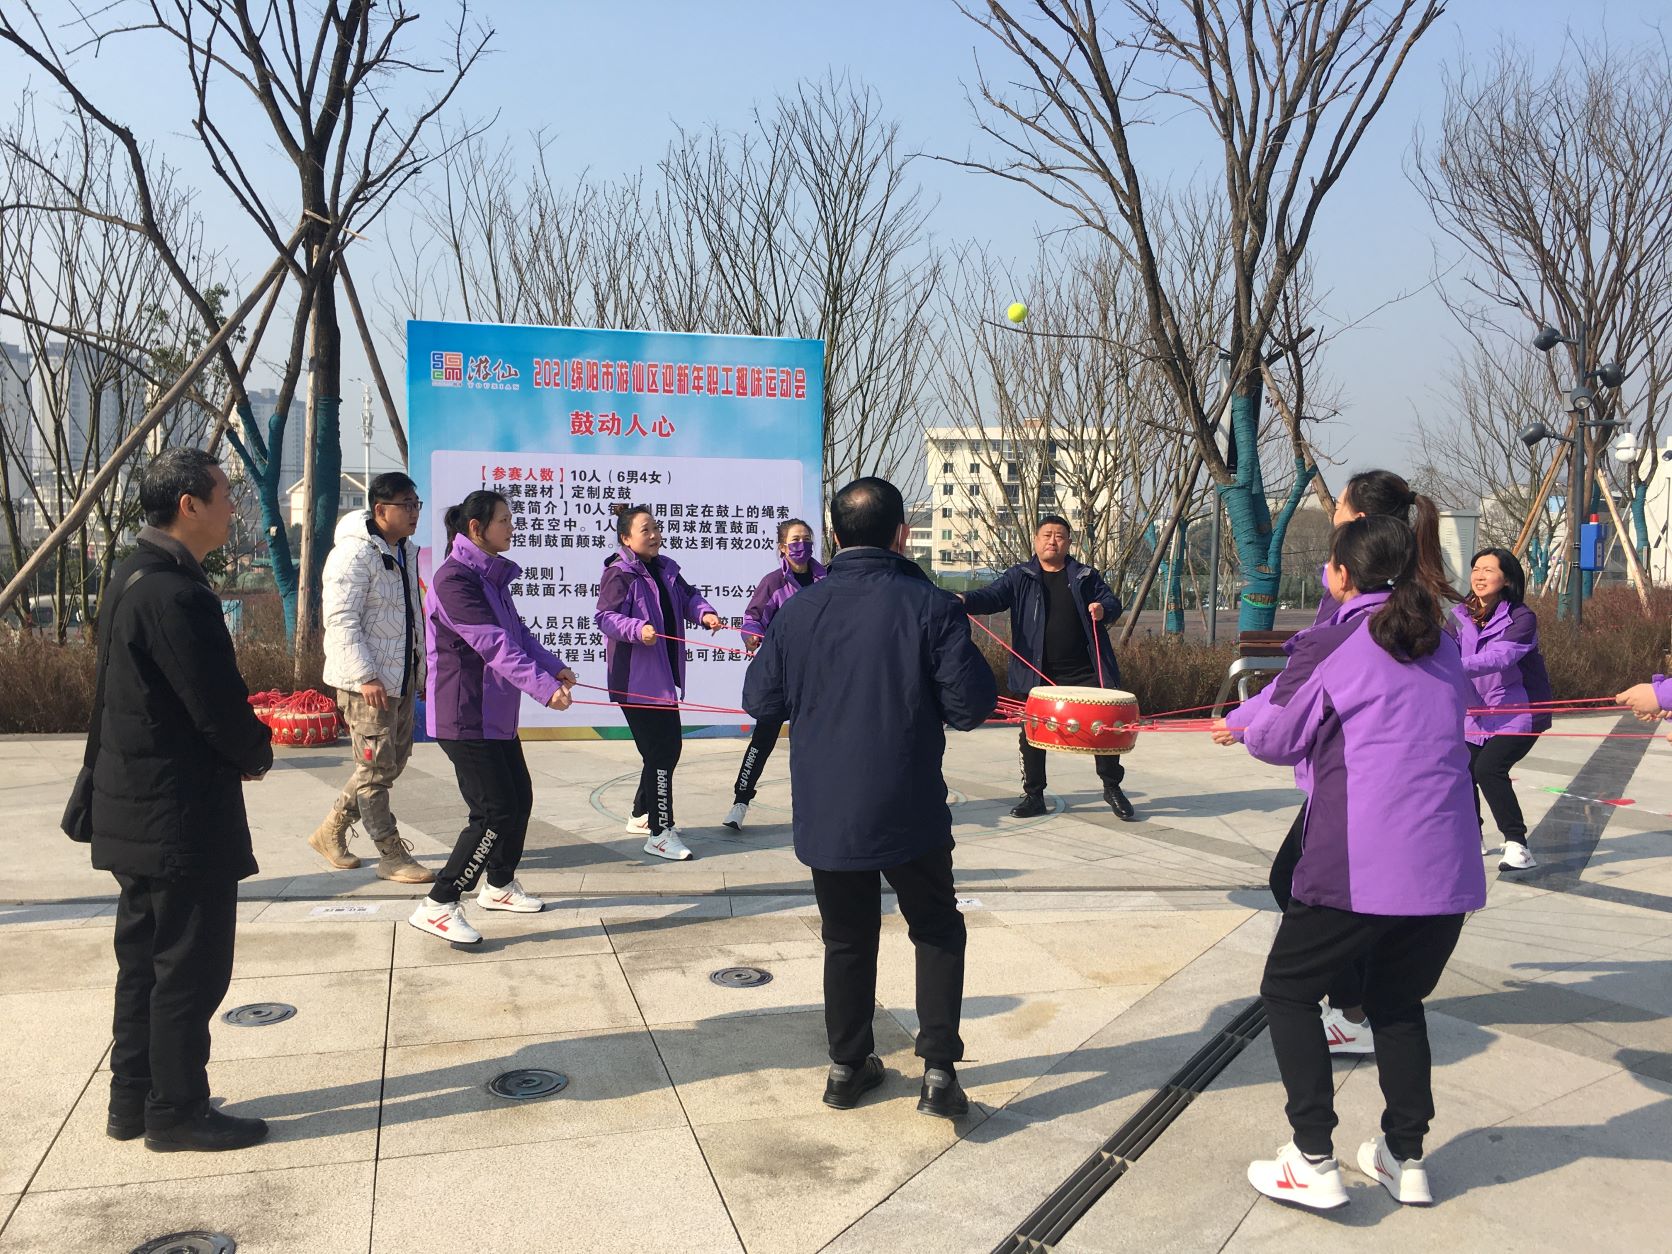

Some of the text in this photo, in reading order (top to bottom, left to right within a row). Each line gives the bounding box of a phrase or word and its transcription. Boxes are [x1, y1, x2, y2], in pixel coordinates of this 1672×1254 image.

[467, 356, 519, 381] 游仙
[534, 358, 806, 399] 2021绵阳市游仙区迎新年职工趣味运动会
[570, 411, 676, 438] 鼓动人心
[515, 566, 564, 581] 规则】
[744, 746, 759, 769] BORN
[741, 769, 751, 780] TO
[656, 768, 669, 829] BORN TO FLY
[472, 828, 499, 864] BORN
[464, 861, 480, 880] TO
